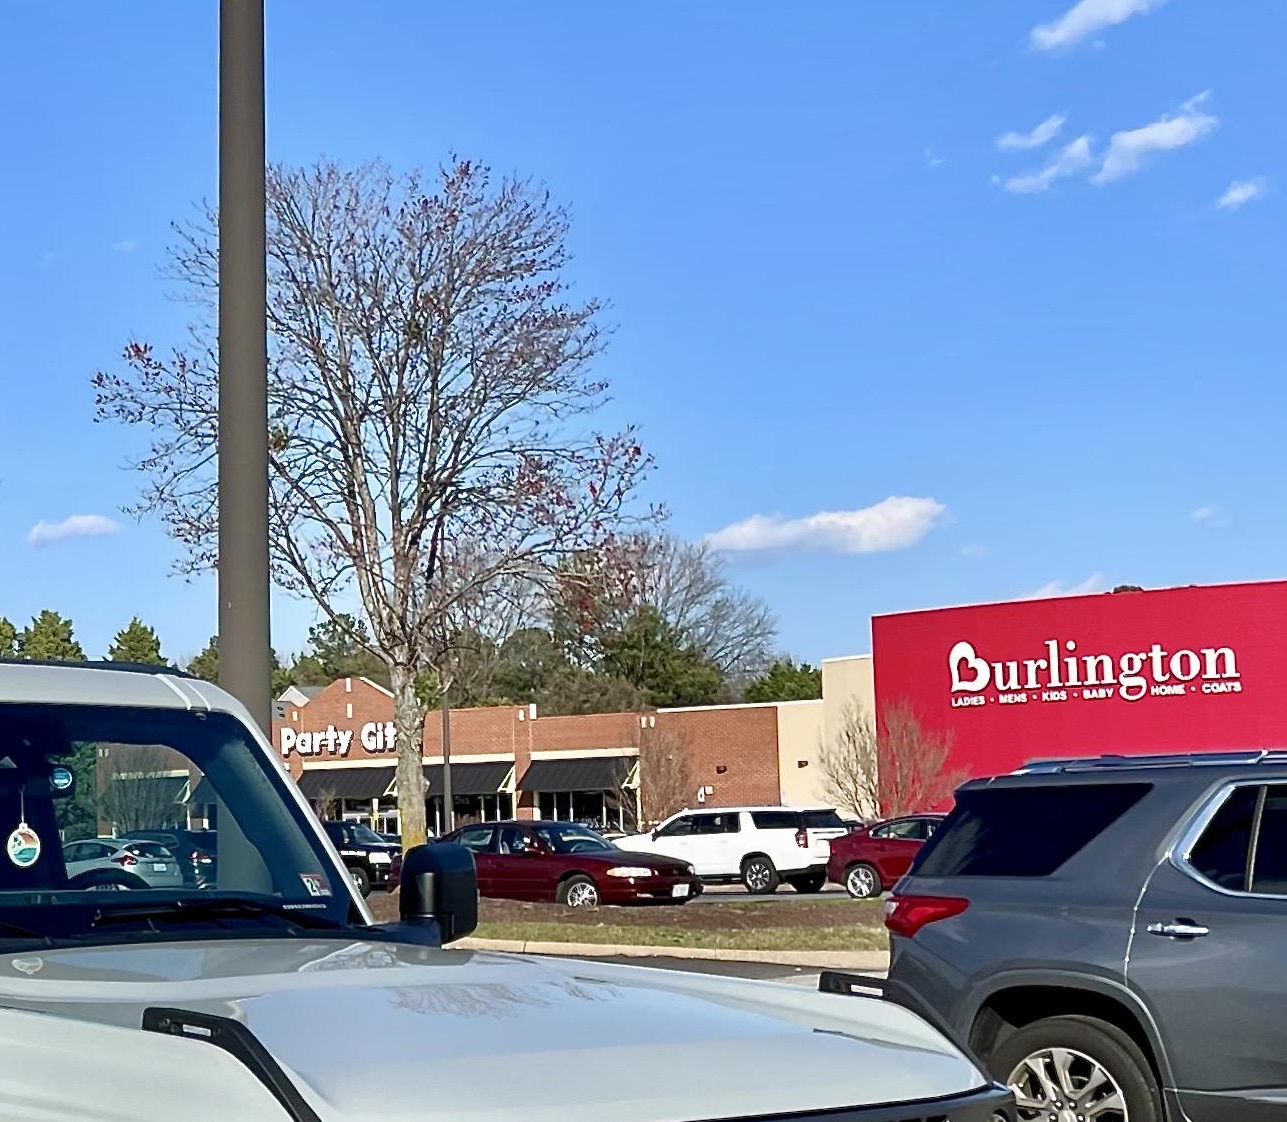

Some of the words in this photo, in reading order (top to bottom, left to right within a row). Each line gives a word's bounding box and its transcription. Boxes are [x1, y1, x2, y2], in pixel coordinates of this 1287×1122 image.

[949, 640, 1241, 700] Burlington
[951, 695, 986, 707] LADIES
[998, 693, 1028, 704] MENS
[1041, 690, 1068, 701] KIDS
[1082, 688, 1114, 699] BABY
[1150, 684, 1186, 695] HOME
[1201, 681, 1243, 693] COATS
[280, 725, 354, 757] Party
[360, 721, 398, 753] Cit
